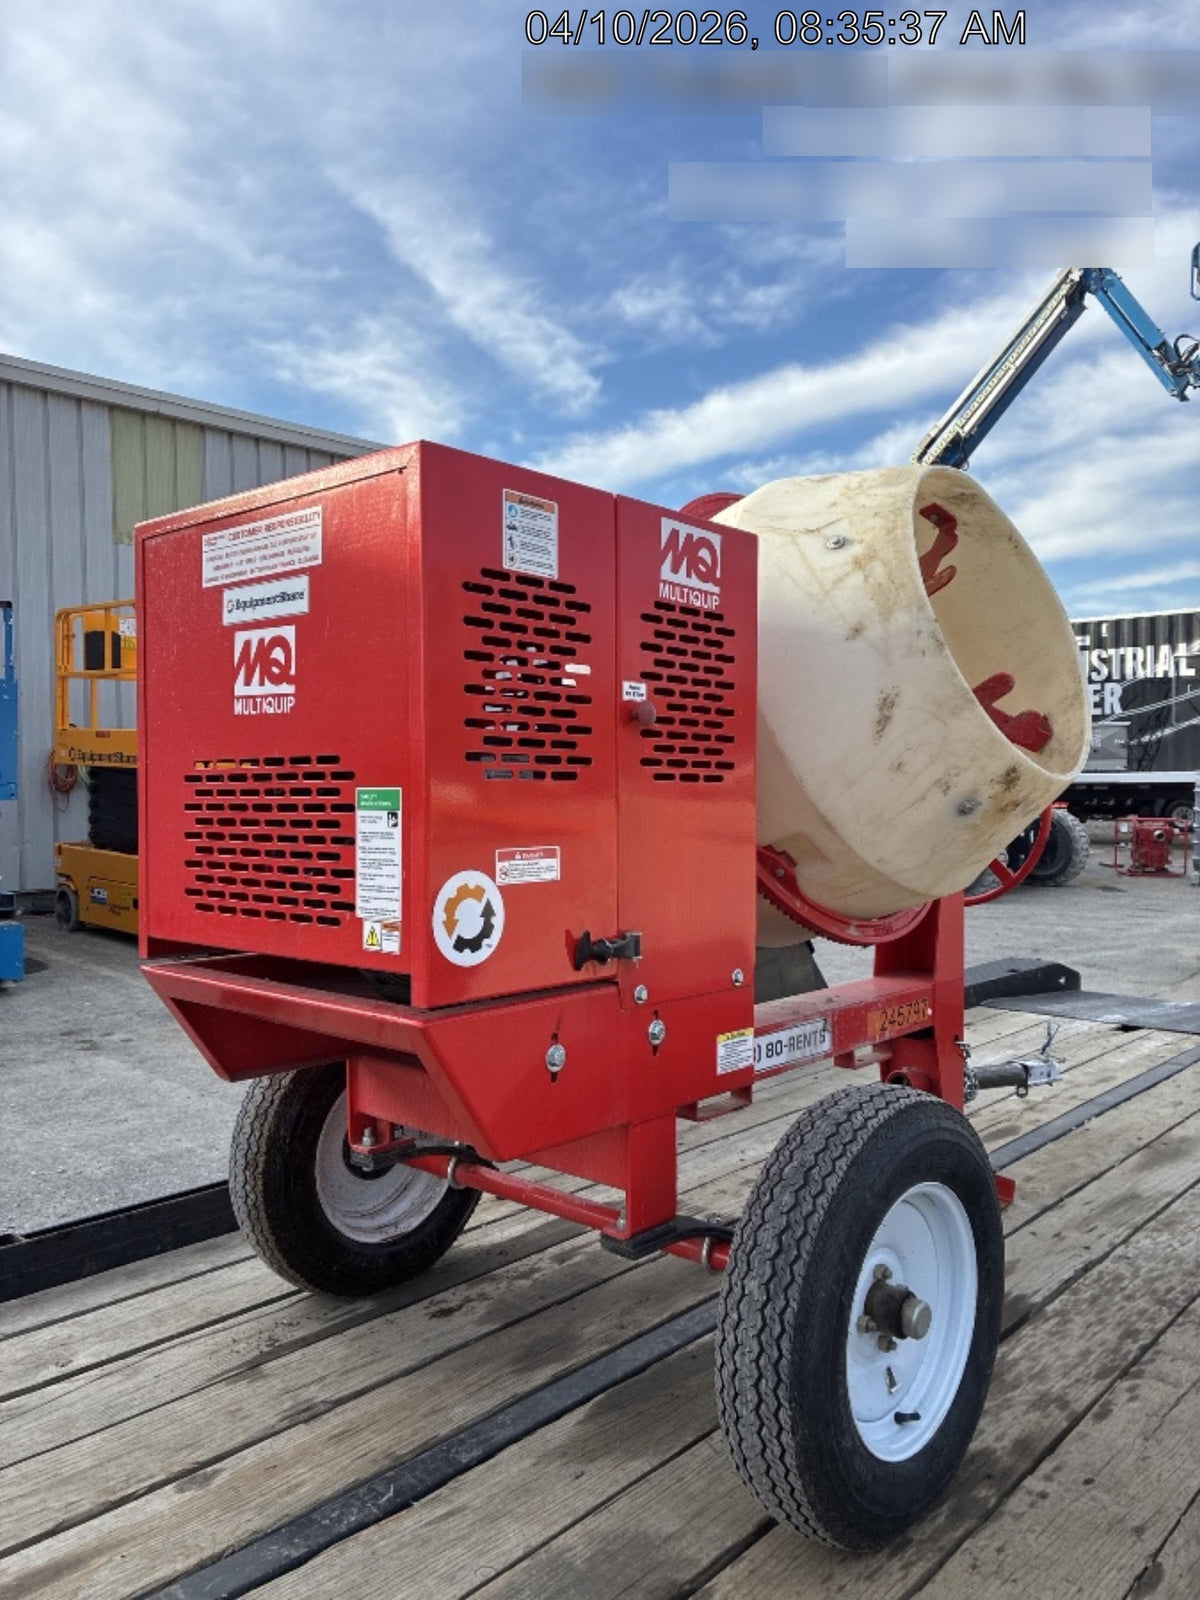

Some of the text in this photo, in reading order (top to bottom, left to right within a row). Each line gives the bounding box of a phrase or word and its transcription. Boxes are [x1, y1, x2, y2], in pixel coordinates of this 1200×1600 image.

[660, 527, 721, 588] MQ
[659, 582, 720, 611] MULTIQUIP
[234, 634, 296, 687] MQ
[233, 696, 296, 716] MULTIQUIP
[765, 1028, 827, 1059] 80-RENTS
